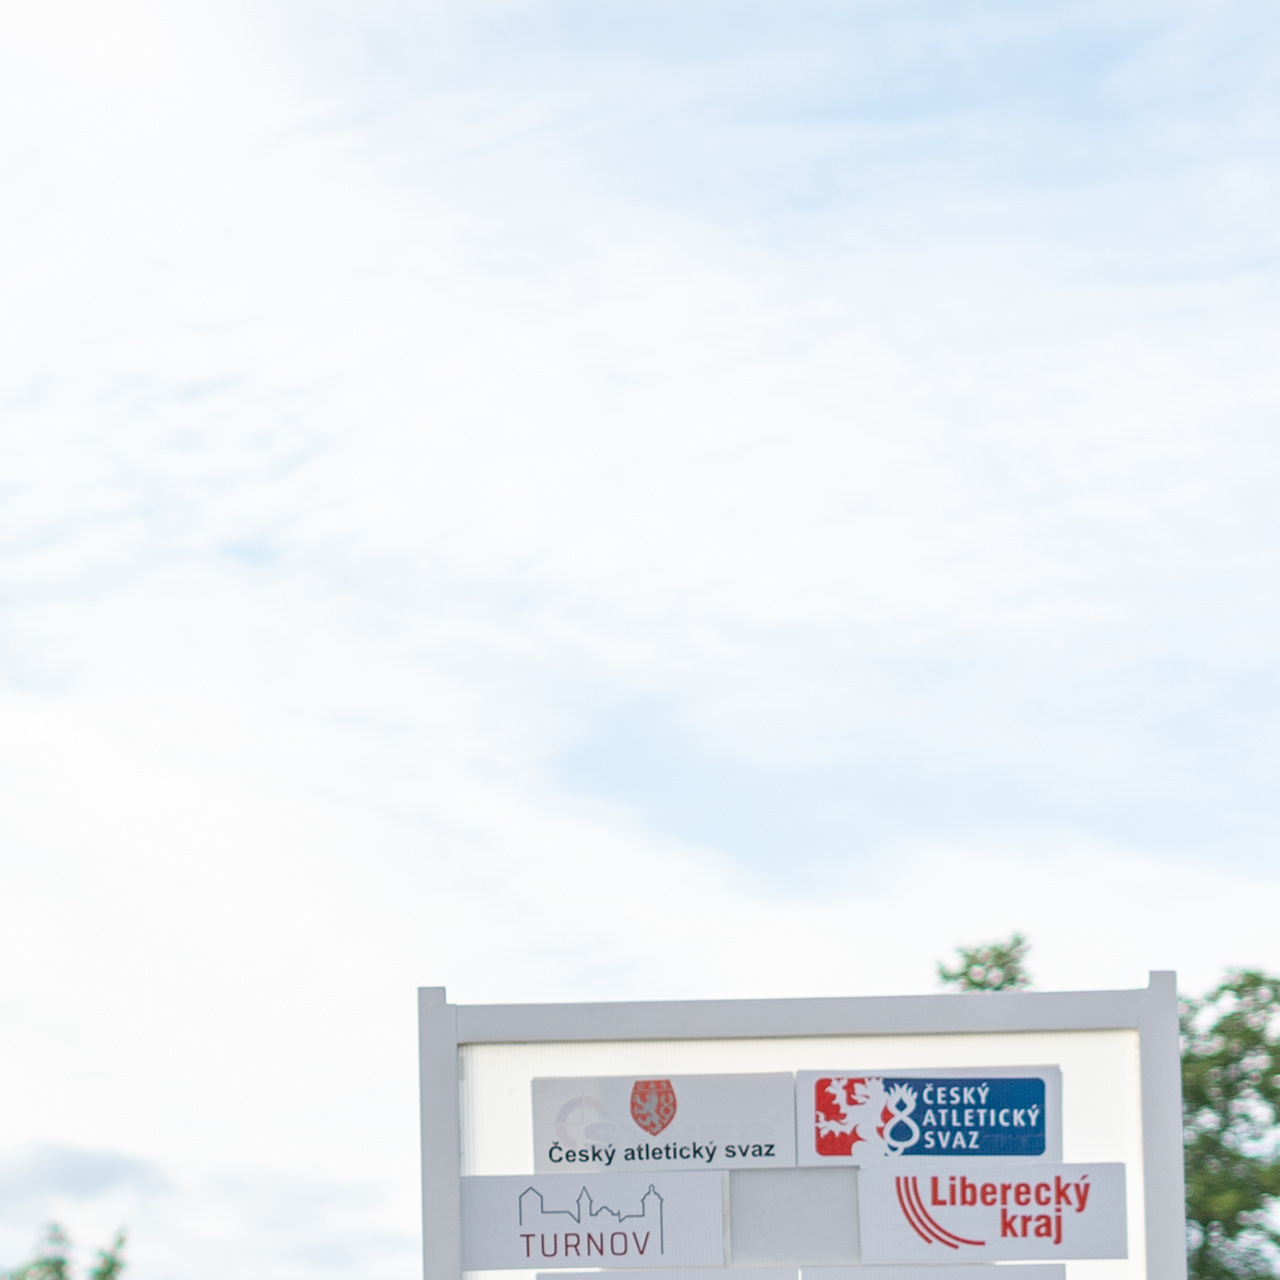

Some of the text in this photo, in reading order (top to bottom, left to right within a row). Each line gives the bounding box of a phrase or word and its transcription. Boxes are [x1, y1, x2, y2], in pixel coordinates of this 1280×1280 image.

[922, 1082, 990, 1105] ČESKÝ
[922, 1104, 1040, 1127] ATLETICKÝ
[548, 1140, 776, 1166] Český atletický svaz
[923, 1130, 980, 1150] SVAZ
[930, 1174, 1091, 1213] Liberecký
[1000, 1207, 1063, 1245] kraj
[520, 1230, 651, 1258] TURNOV
